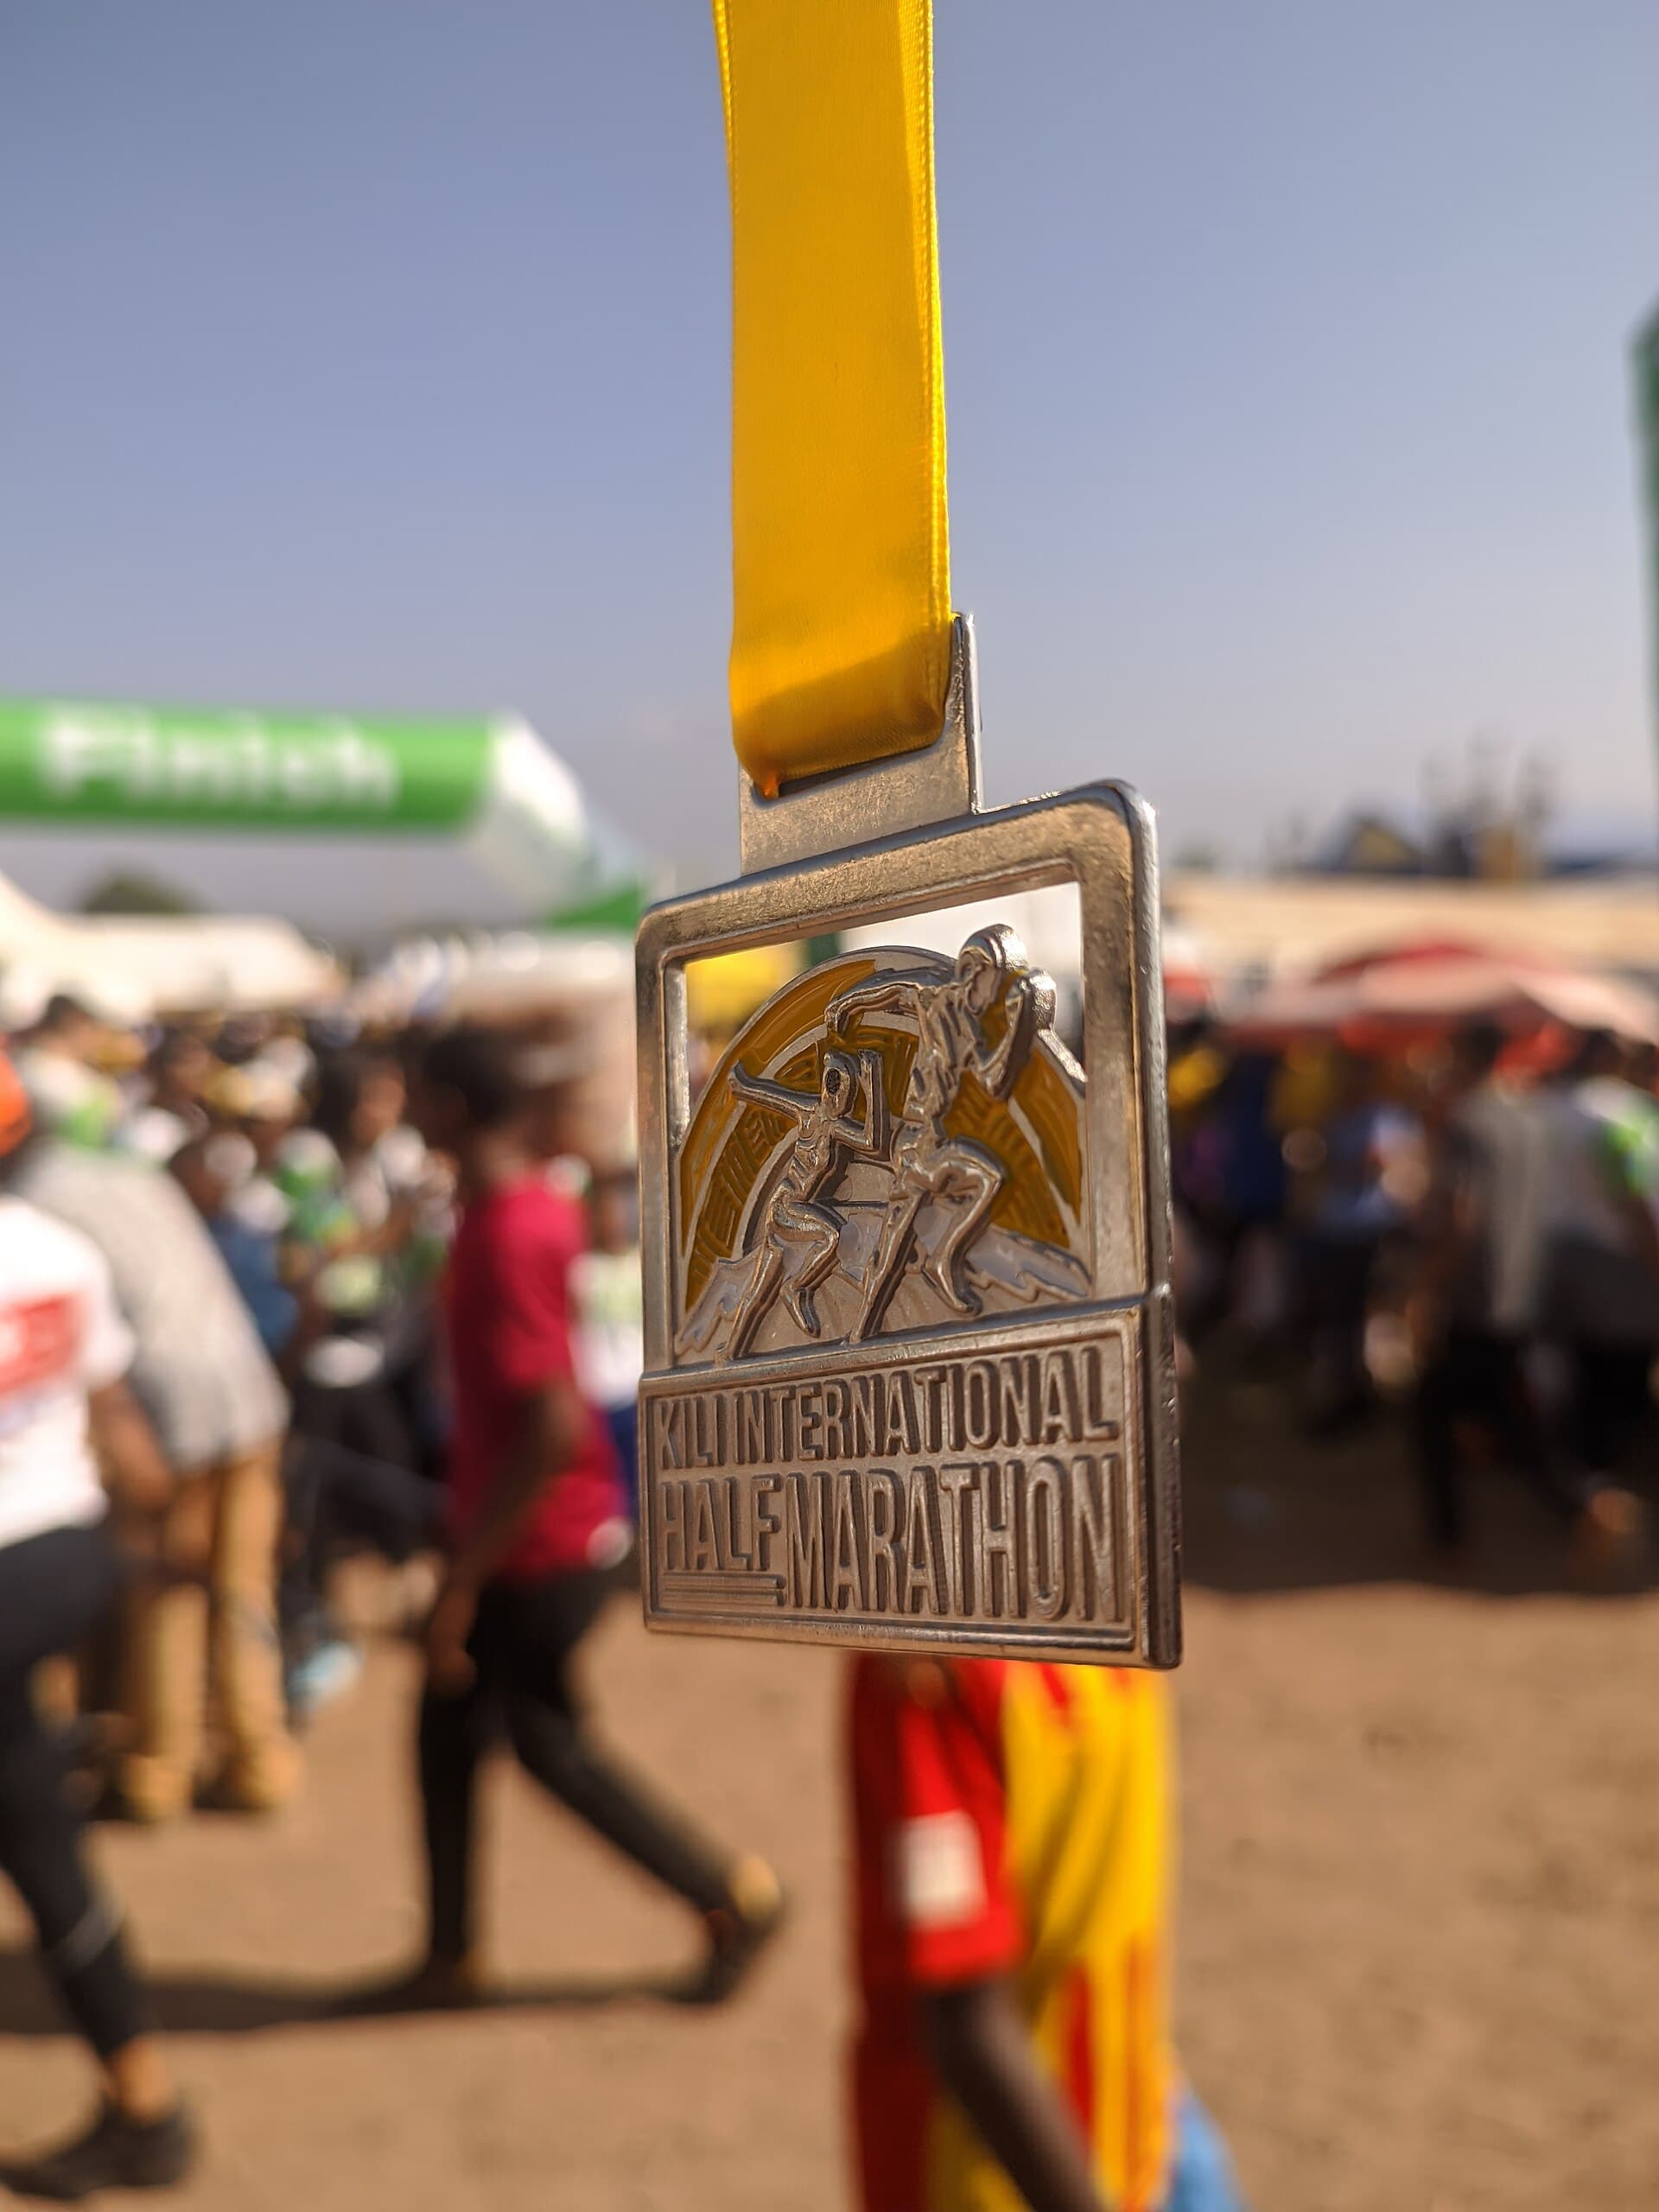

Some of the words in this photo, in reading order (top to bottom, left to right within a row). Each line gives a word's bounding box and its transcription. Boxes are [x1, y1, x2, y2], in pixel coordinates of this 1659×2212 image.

[657, 1394, 724, 1469] KILI
[734, 1345, 1121, 1463] INTERNATIONAL
[658, 1473, 781, 1573] HALF
[785, 1453, 1123, 1623] MARATHON
